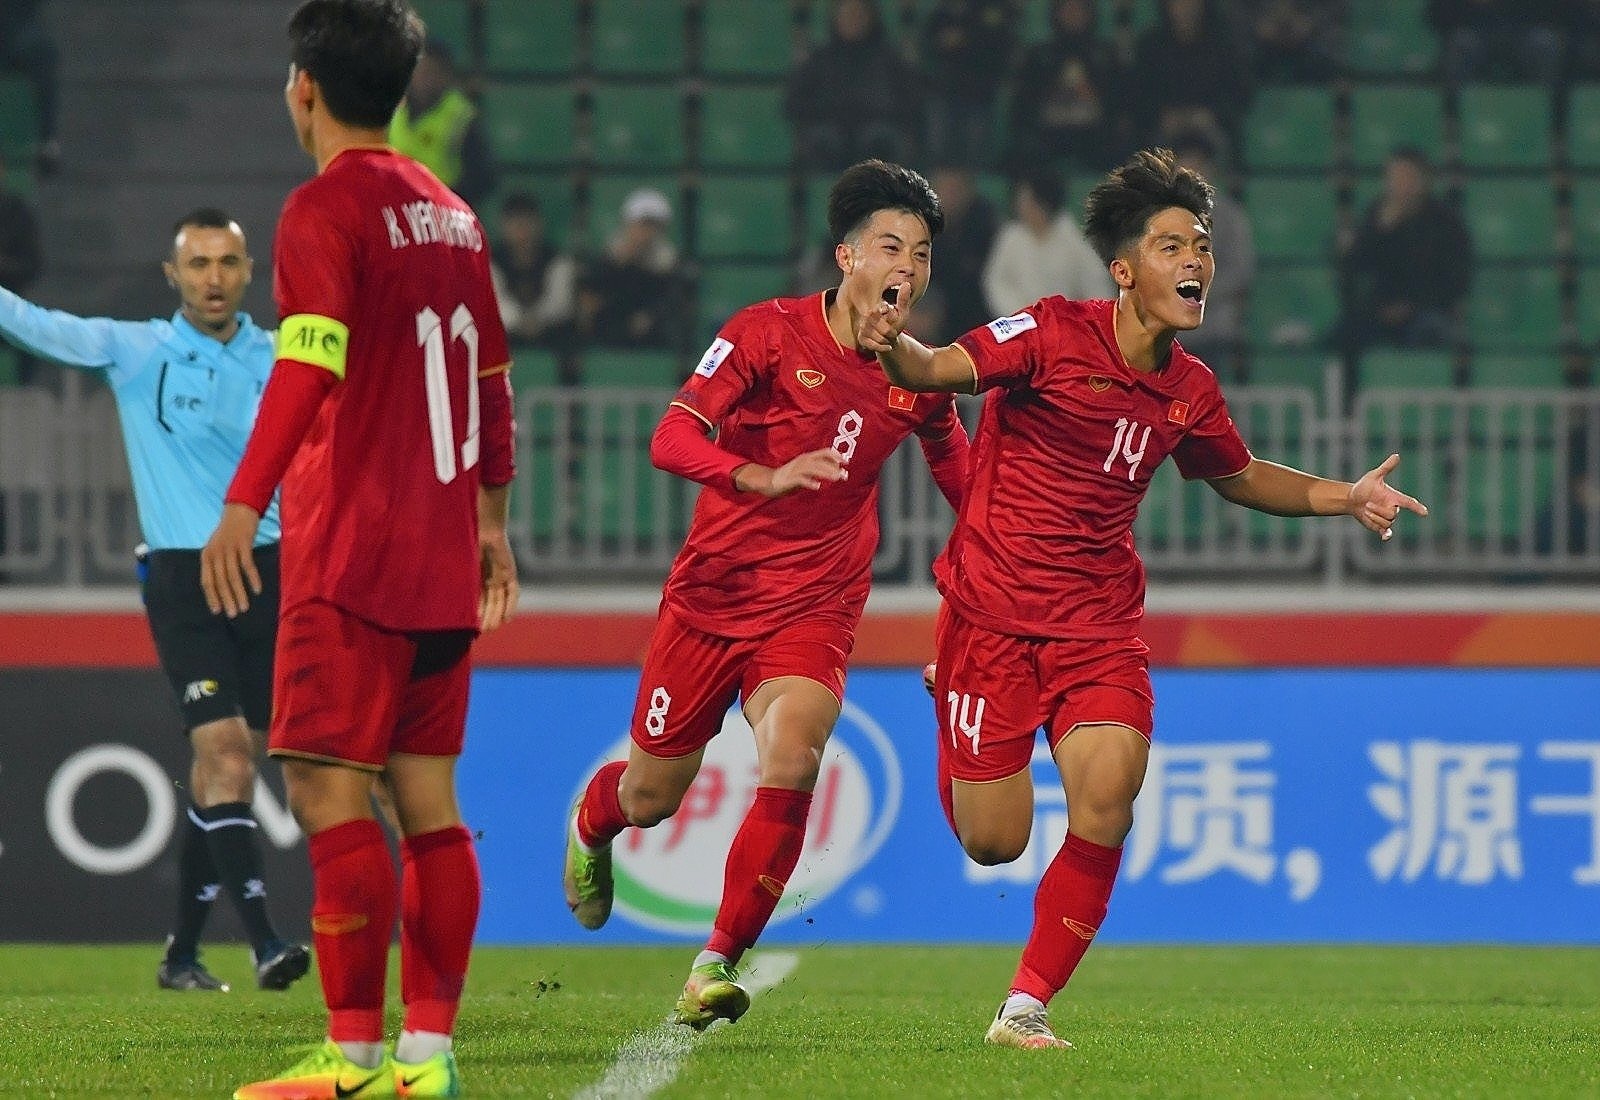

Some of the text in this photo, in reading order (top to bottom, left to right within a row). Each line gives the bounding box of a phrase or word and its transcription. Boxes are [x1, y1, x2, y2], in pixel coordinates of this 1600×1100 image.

[831, 409, 864, 464] 8
[1103, 417, 1152, 482] 14
[645, 686, 672, 737] 8
[947, 690, 986, 756] 14
